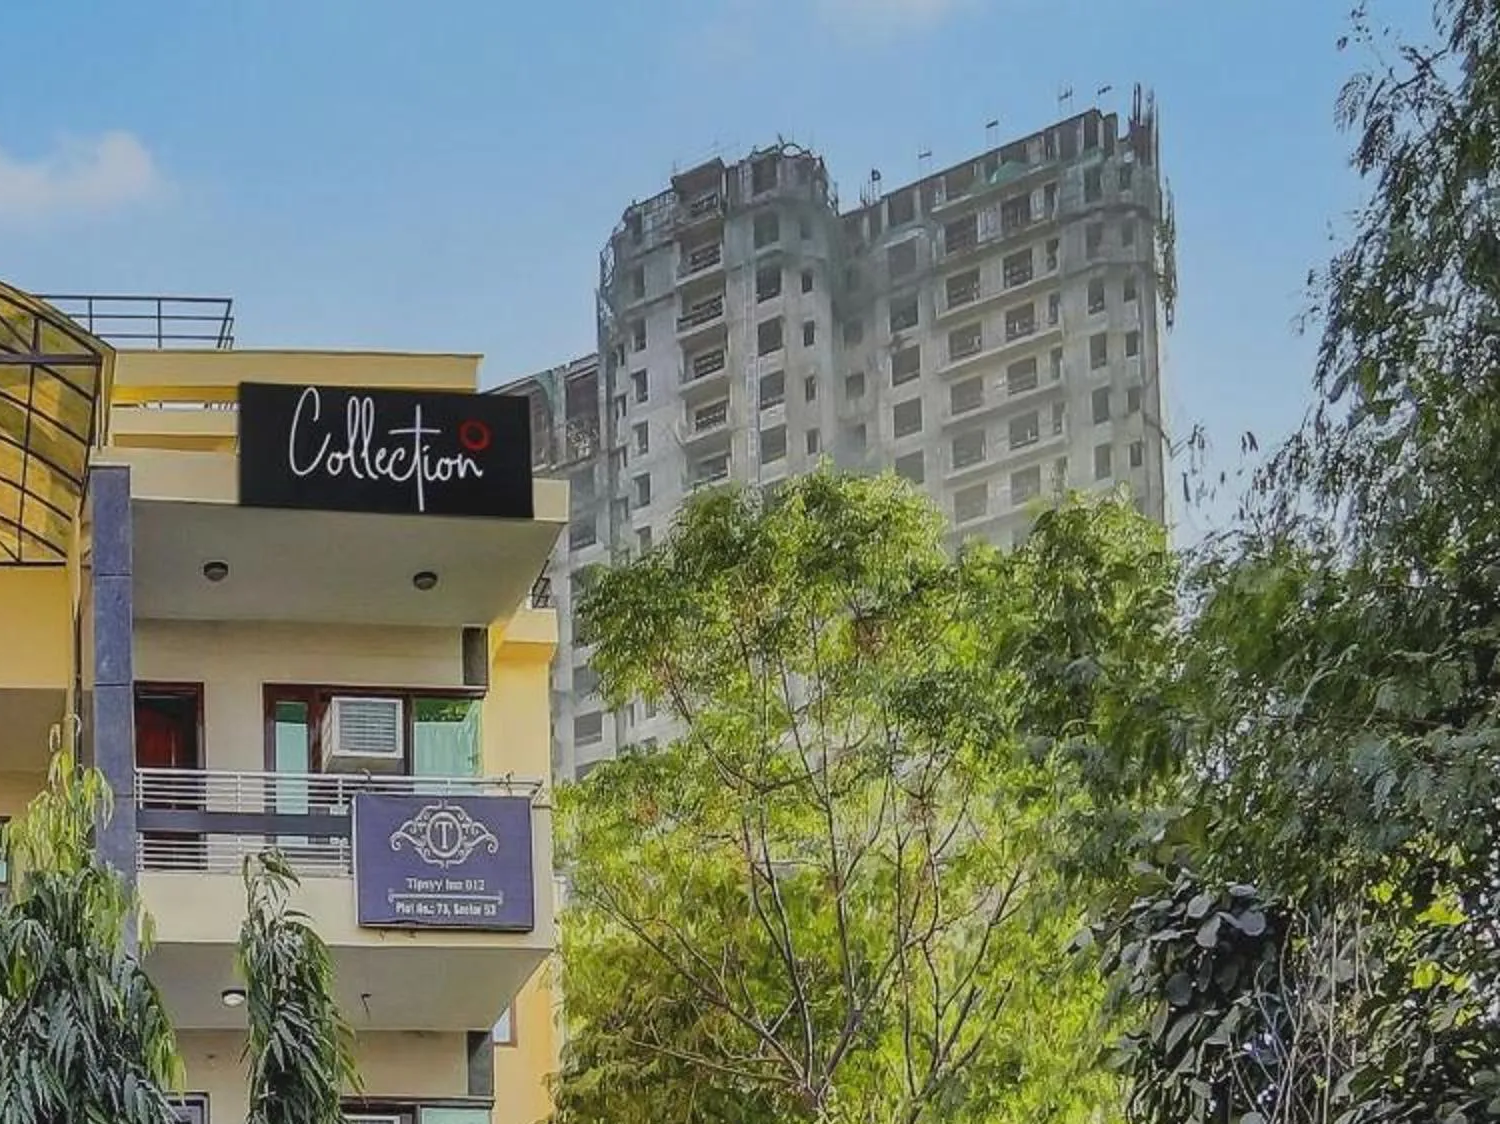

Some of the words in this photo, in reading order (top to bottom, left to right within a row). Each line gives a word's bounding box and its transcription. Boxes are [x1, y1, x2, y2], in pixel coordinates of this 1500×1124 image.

[289, 386, 484, 512] Collection
[435, 821, 453, 850] T
[465, 878, 485, 891] 012
